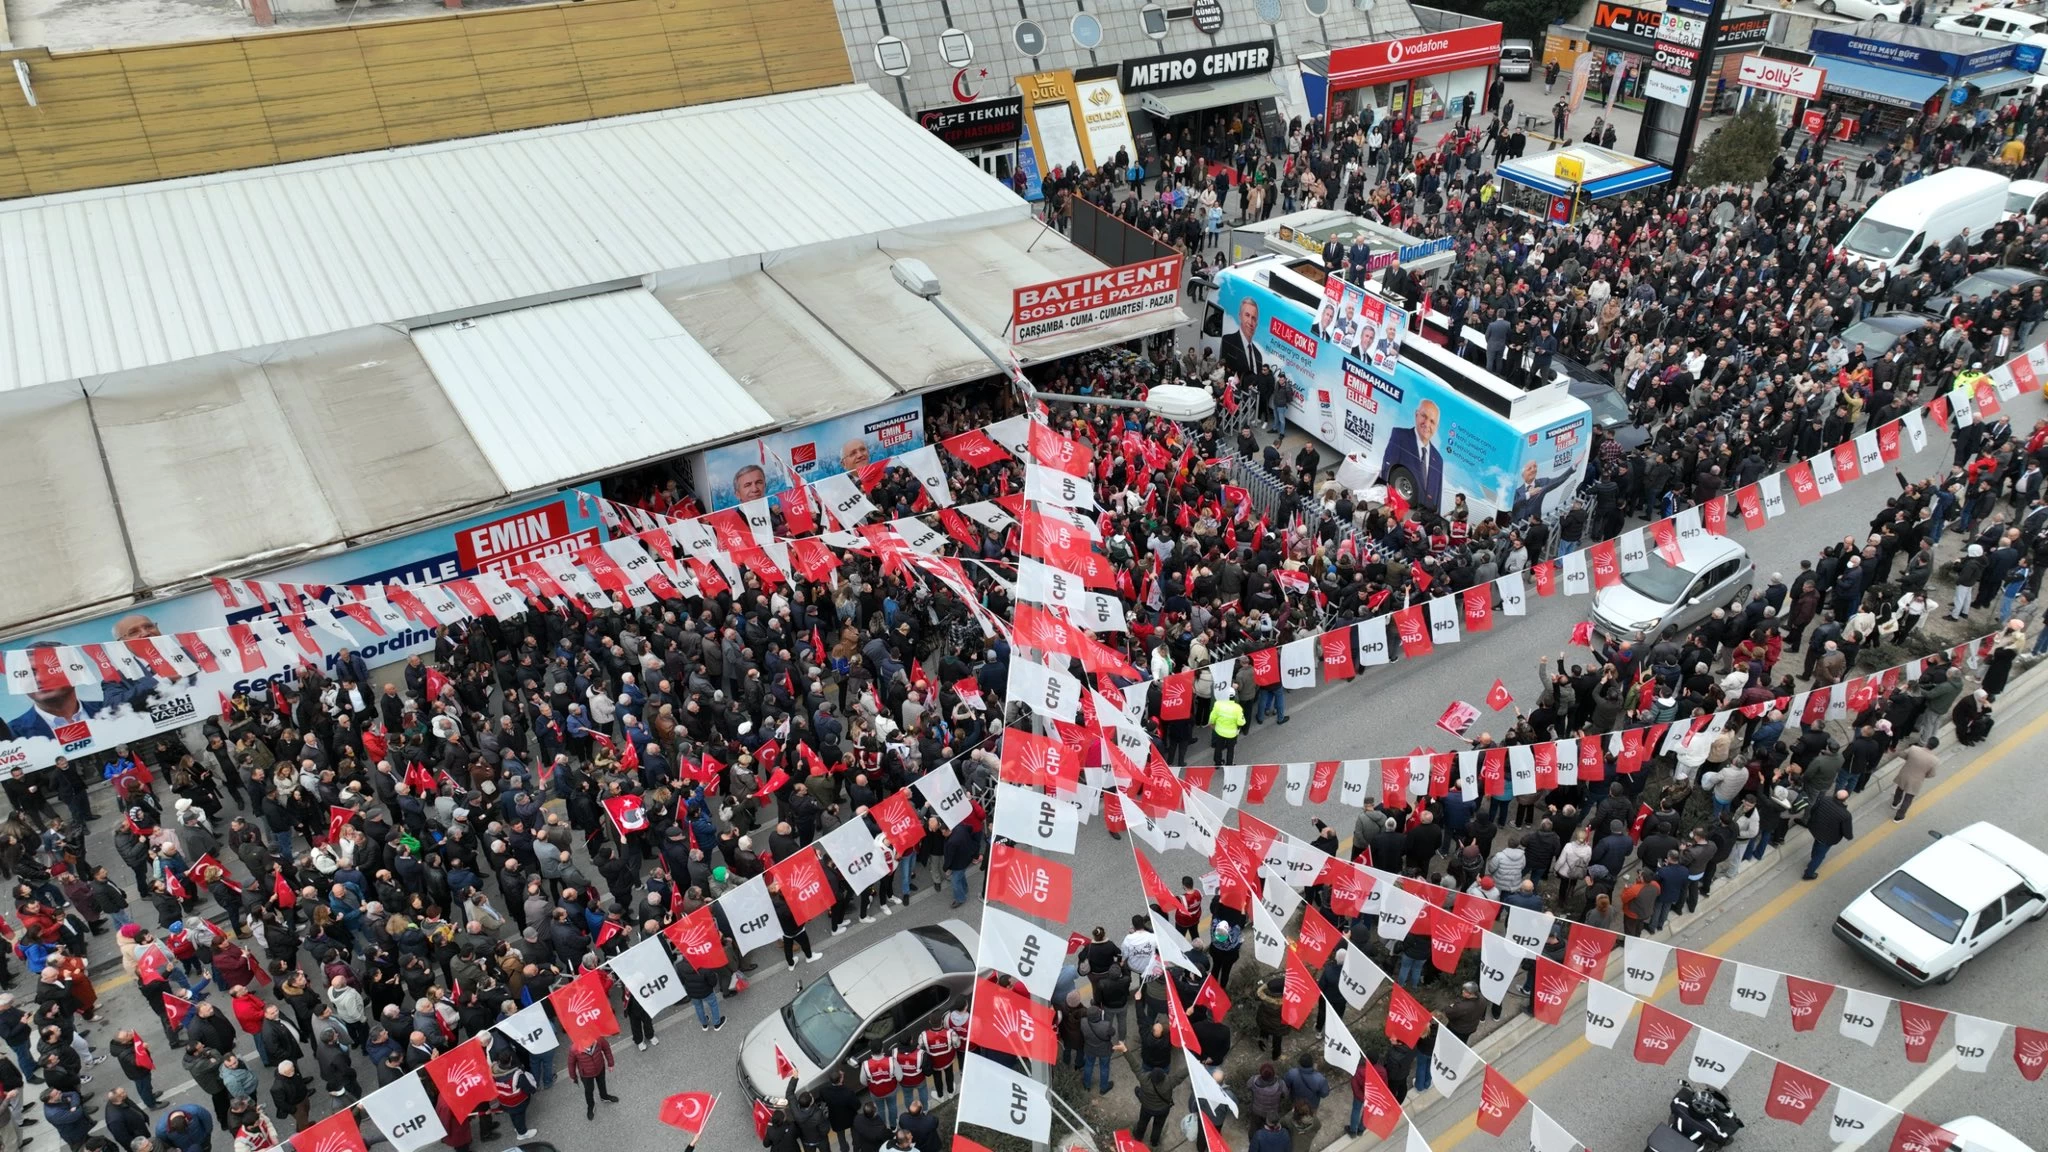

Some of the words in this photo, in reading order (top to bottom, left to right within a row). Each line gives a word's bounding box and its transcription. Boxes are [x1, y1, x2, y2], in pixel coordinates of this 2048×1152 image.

[1662, 13, 1691, 31] bebe
[1727, 28, 1766, 41] CENTER
[1405, 39, 1448, 55] vodafone
[1658, 44, 1695, 58] GÖZDECAN
[1848, 41, 1878, 52] CENTER
[1898, 50, 1920, 60] BÜFE
[1131, 59, 1196, 87] METRO
[1203, 48, 1269, 77] CENTER
[1656, 51, 1693, 70] Optik
[1757, 66, 1792, 88] Jolly
[1031, 85, 1066, 100] DURU
[938, 112, 965, 126] EFE
[1400, 236, 1453, 262] Dondurma
[1020, 260, 1178, 308] BATIKENT
[1020, 294, 1103, 320] SOSYETE
[1109, 278, 1170, 301] PAZARI
[1019, 319, 1064, 342] ÇARŞAMBA
[1070, 312, 1093, 328] CUMA
[1100, 298, 1144, 320] CUMARTESİ
[1150, 293, 1174, 309] PAZAR
[1272, 321, 1282, 335] AZ
[1294, 333, 1308, 351] ÇOK
[1346, 362, 1400, 399] YENİMAHALLE
[1348, 391, 1376, 414] ELLERDE
[867, 414, 916, 431] YENİMAHALLE
[1346, 409, 1374, 433] Fethi
[1346, 420, 1374, 442] YAŞAR
[884, 432, 912, 448] ELLERDE
[968, 443, 990, 457] CHP
[1061, 441, 1075, 462] CHP
[795, 462, 816, 473] CHP
[1062, 478, 1076, 500] CHP
[1798, 482, 1813, 493] CHP
[838, 494, 862, 512] CHP
[913, 532, 936, 548] CHP
[1060, 527, 1070, 550] CHP
[595, 564, 612, 575] CHP
[627, 555, 648, 571] CHP
[762, 565, 778, 576] CHP
[810, 554, 830, 571] CHP
[586, 590, 602, 600] CHP
[628, 586, 646, 597] CHP
[1053, 574, 1066, 600] CHP
[492, 592, 512, 606] CHP
[1056, 624, 1068, 644] CHP
[1046, 677, 1062, 709] CHP
[152, 703, 194, 720] YAŞAR
[64, 739, 91, 752] CHP
[1046, 746, 1060, 775] CHP
[940, 788, 964, 811] CHP
[890, 816, 912, 835] CHP
[1038, 801, 1056, 838] CHP
[848, 851, 875, 876] CHP
[798, 880, 821, 902] CHP
[1034, 868, 1050, 903] CHP
[740, 913, 770, 934] CHP
[686, 942, 713, 956] CHP
[1018, 934, 1041, 977] CHP
[640, 974, 670, 998] CHP
[576, 1008, 601, 1027] CHP
[1020, 1009, 1035, 1042] CHP
[456, 1075, 481, 1097] CHP
[1010, 1082, 1028, 1125] CHP
[392, 1114, 427, 1139] CHP
